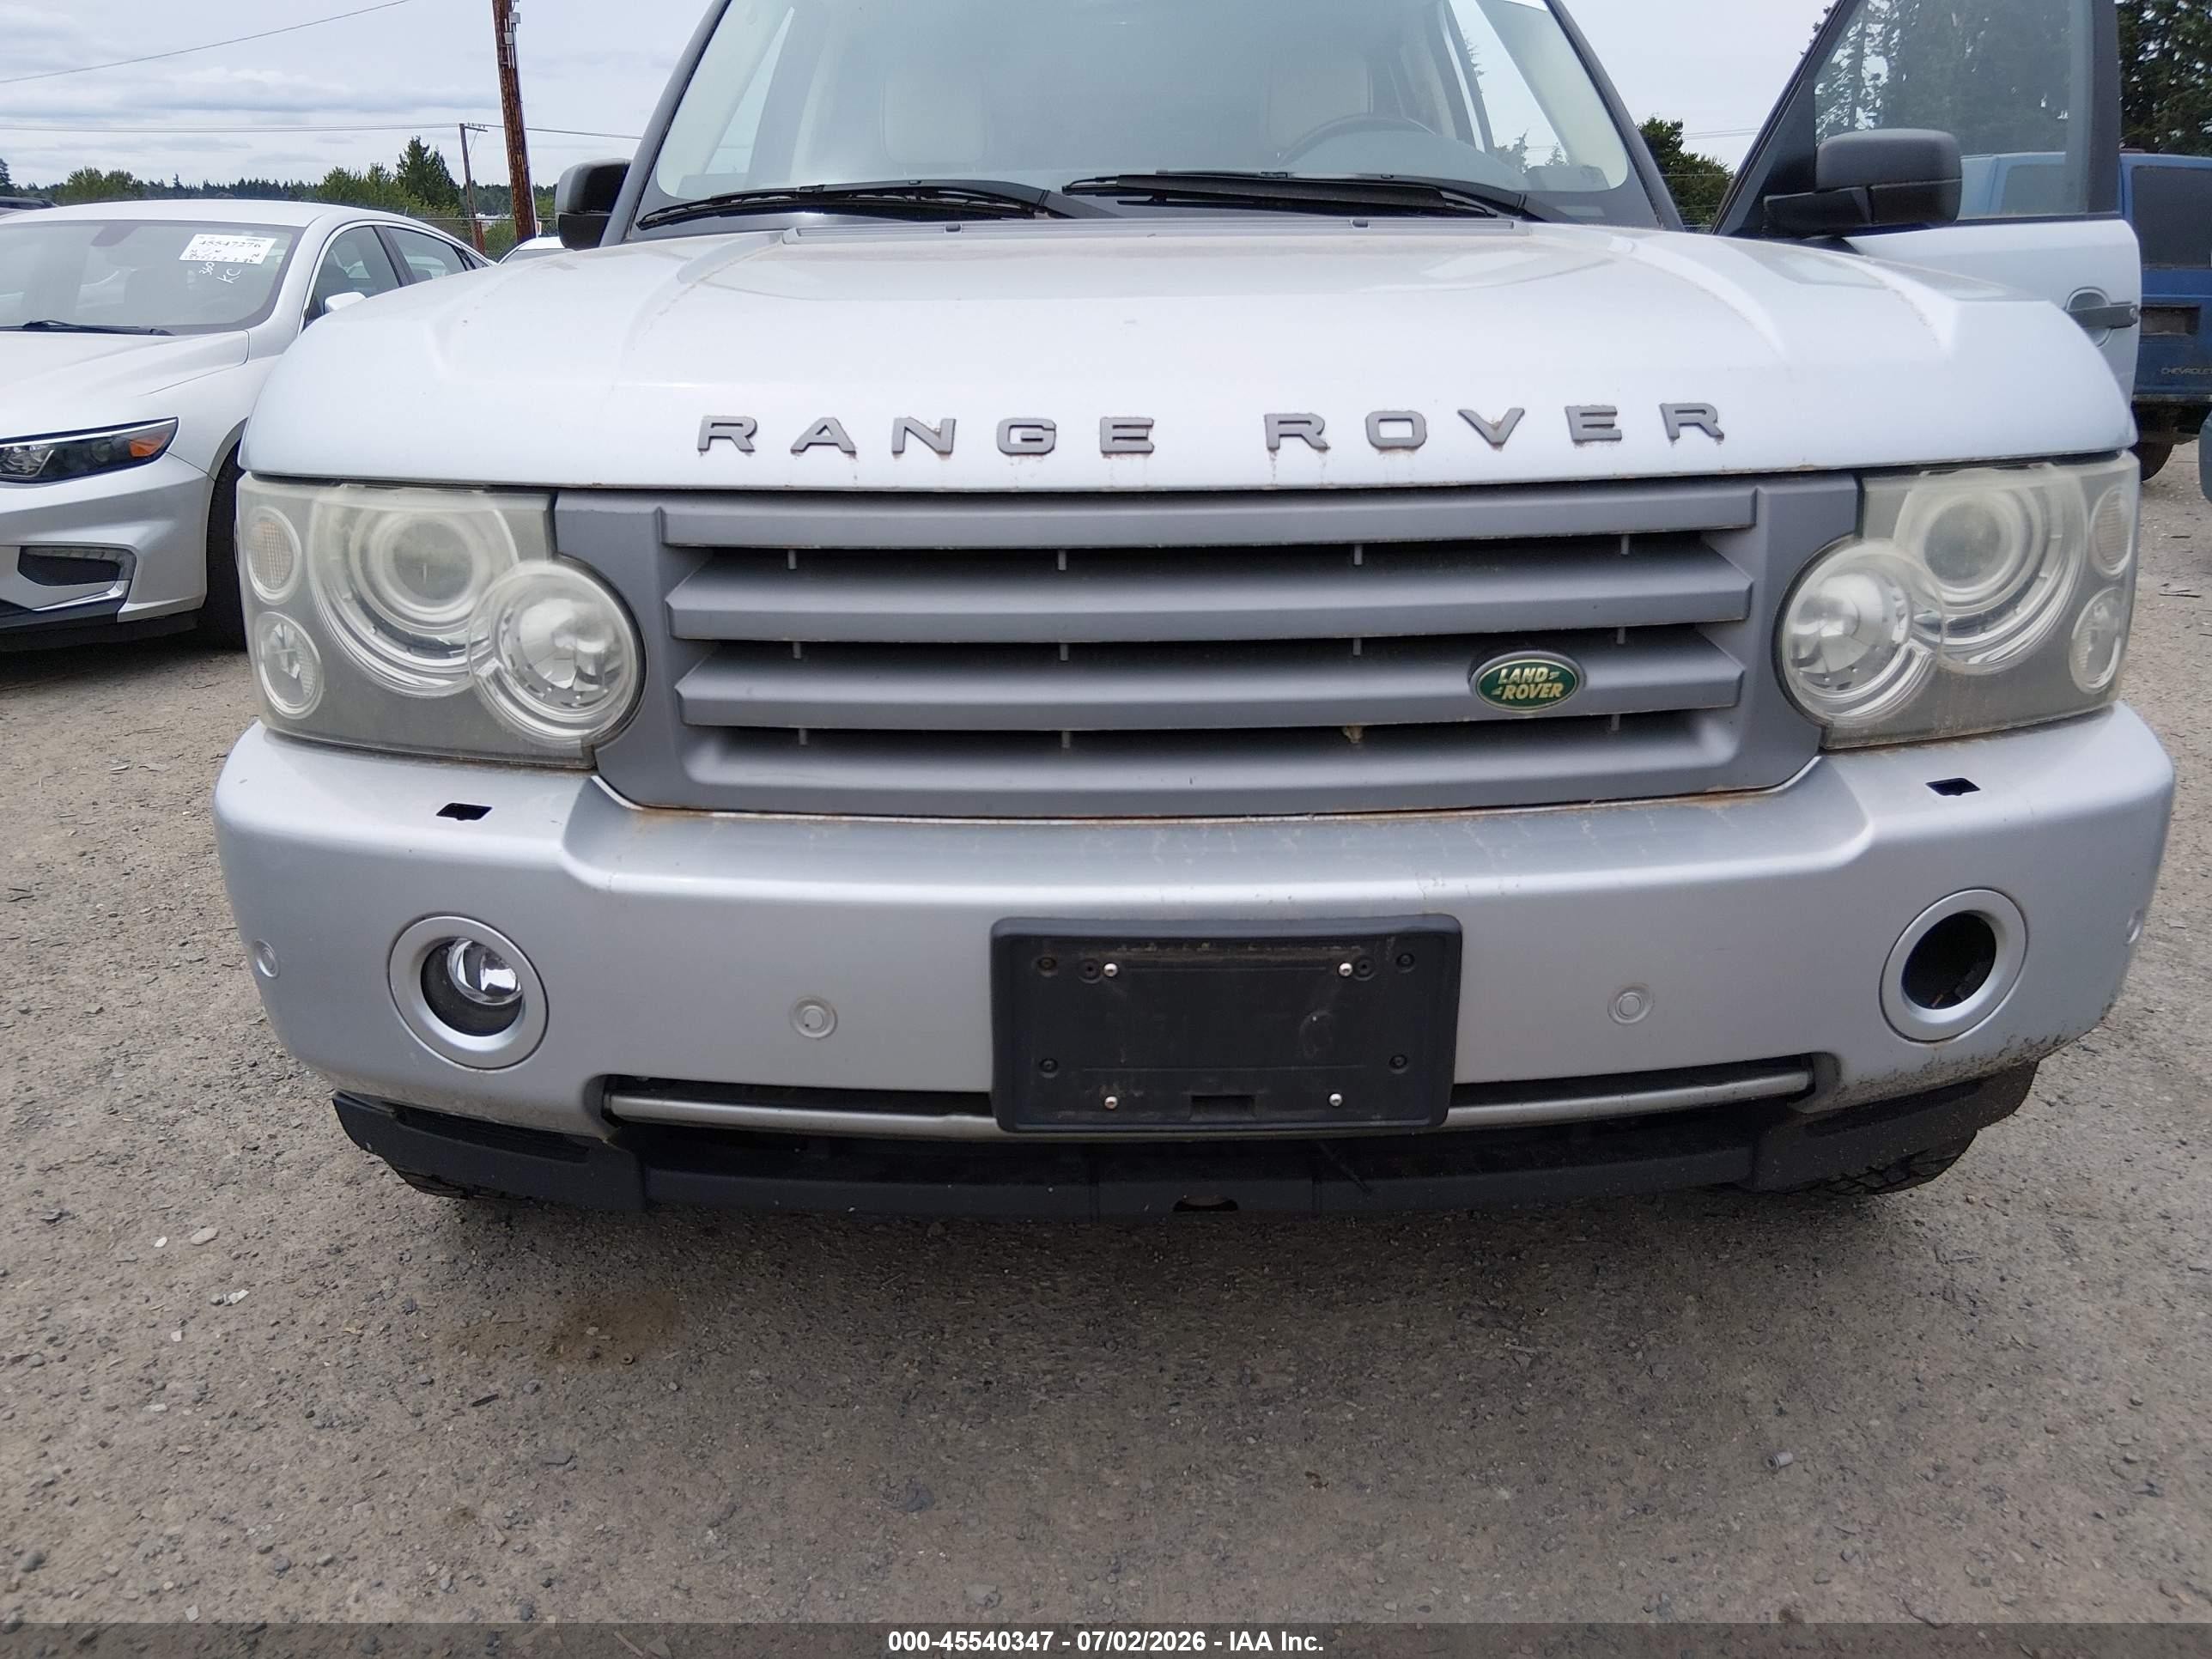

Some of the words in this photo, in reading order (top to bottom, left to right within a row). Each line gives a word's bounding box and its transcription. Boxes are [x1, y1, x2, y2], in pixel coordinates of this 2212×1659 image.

[697, 415, 1155, 454] RANGE
[1264, 403, 1725, 450] ROVER
[1498, 665, 1549, 685] LAND
[1501, 683, 1565, 700] ROVER
